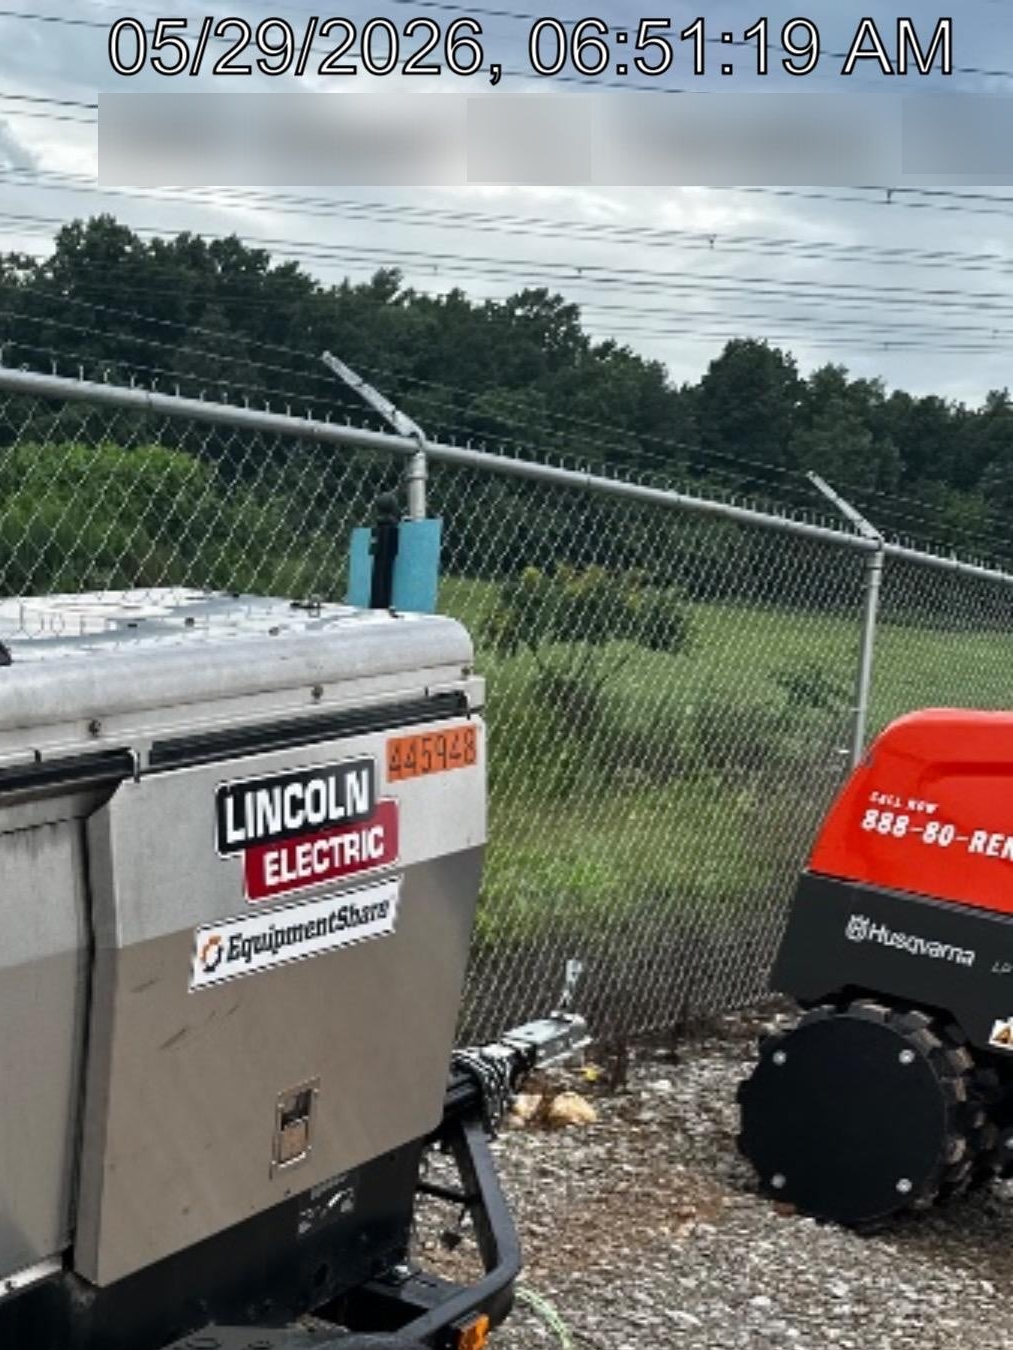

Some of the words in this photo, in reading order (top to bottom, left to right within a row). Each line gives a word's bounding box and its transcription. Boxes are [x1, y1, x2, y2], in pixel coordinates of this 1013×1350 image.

[388, 727, 476, 777] 445948
[225, 768, 370, 844] LINCOLN
[263, 825, 385, 887] ELECTRIC
[226, 899, 390, 963] EquipmentShare
[868, 921, 975, 967] Husqvarna
